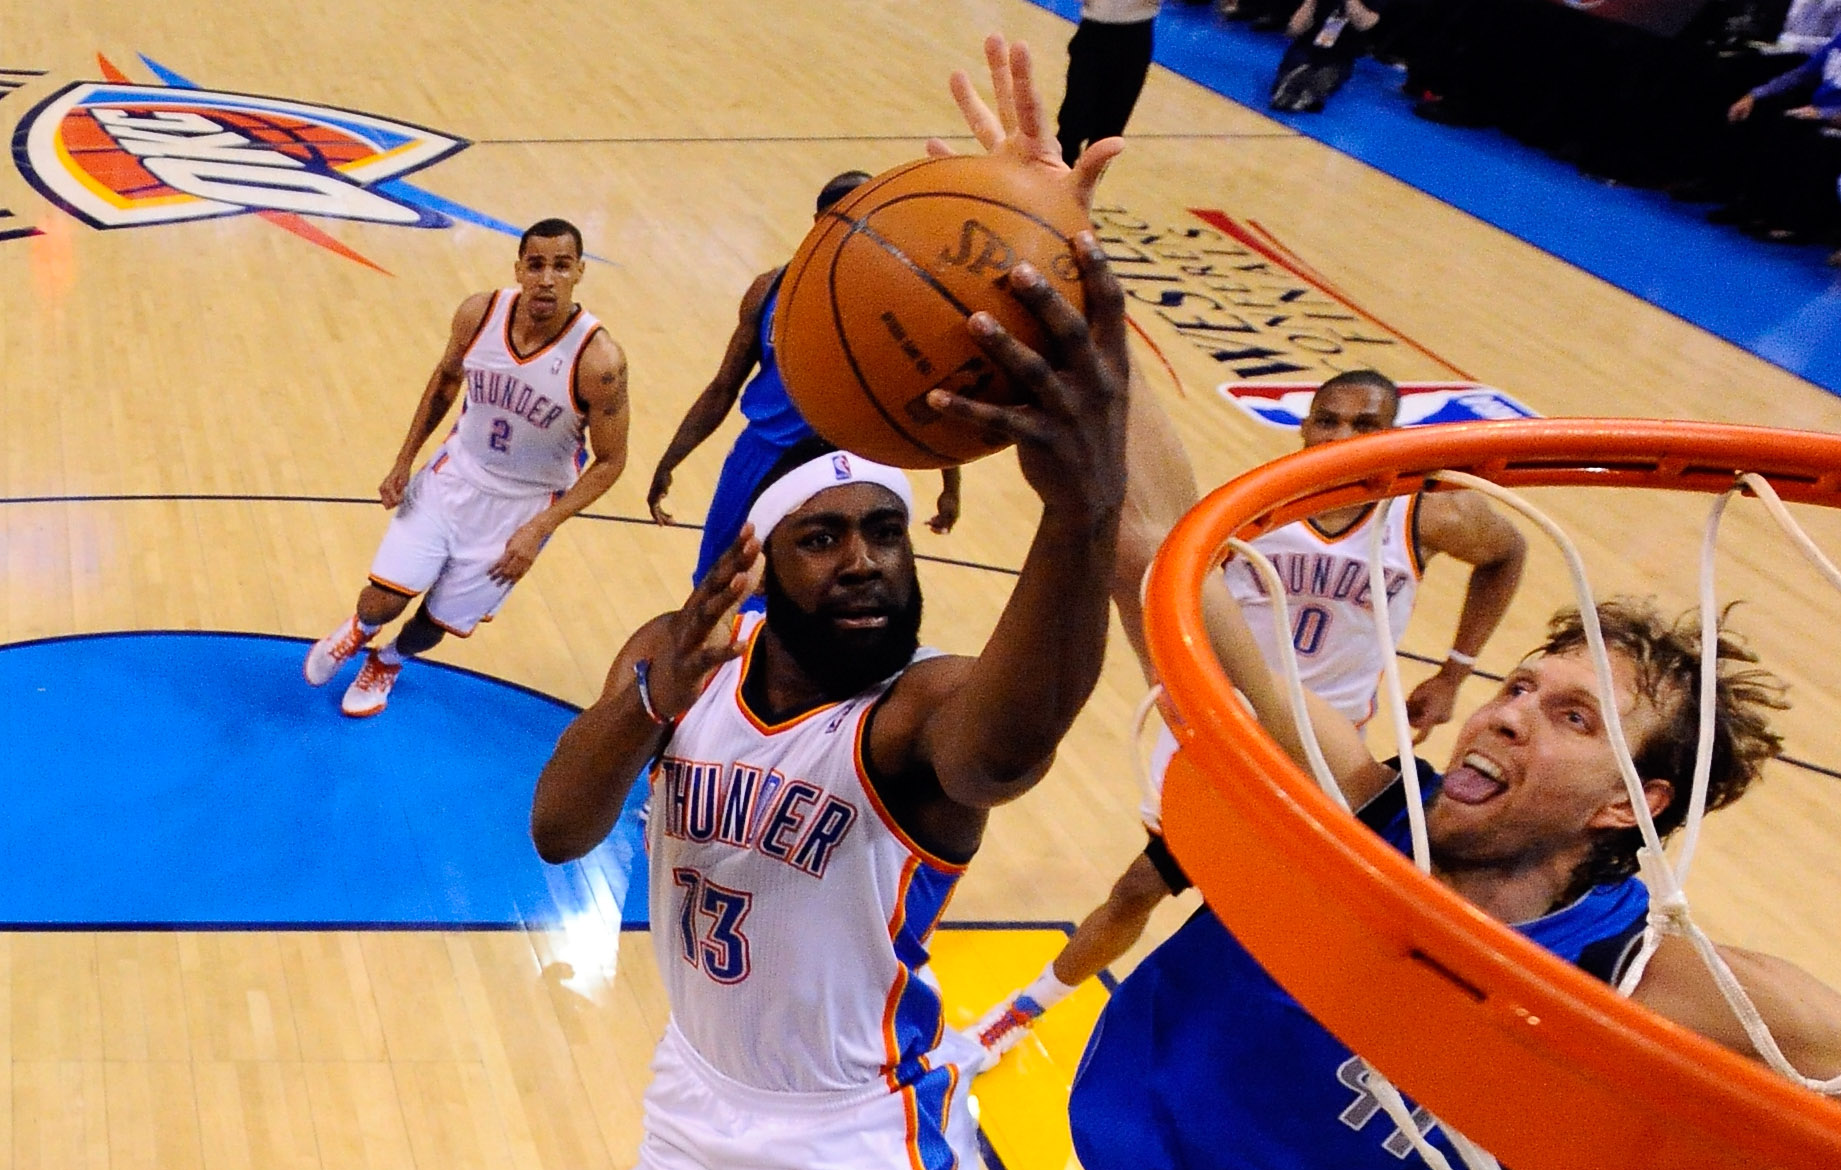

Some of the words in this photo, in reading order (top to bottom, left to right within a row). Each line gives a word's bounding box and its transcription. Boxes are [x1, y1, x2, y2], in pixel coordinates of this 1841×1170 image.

[1165, 226, 1397, 345] FINALS
[489, 418, 514, 453] 2
[1291, 603, 1334, 656] 0
[673, 868, 752, 985] 13
